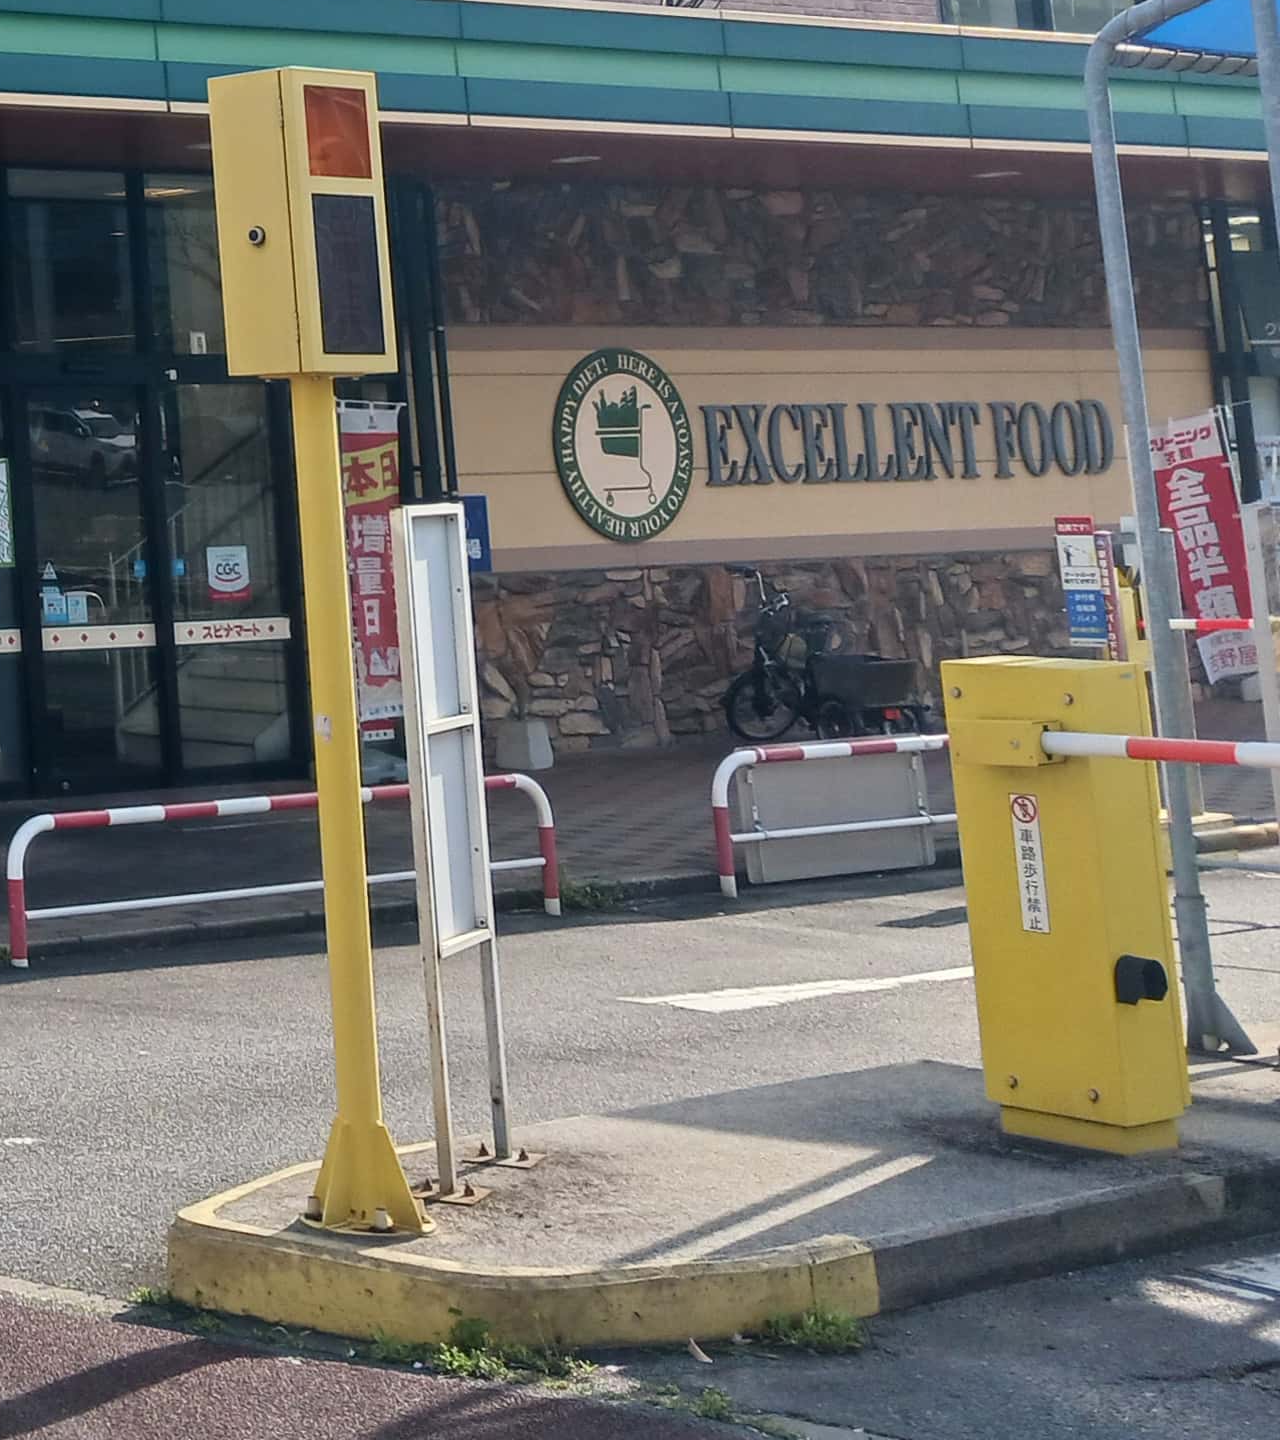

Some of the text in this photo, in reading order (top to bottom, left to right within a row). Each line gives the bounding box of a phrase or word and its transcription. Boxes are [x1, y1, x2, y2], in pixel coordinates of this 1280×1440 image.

[560, 354, 690, 537] HERE IS A TOAST TO YOUR HEALTHY HAPPY DIET!
[700, 399, 1115, 486] EXCELLENT FOOD
[216, 563, 240, 575] CGC
[351, 514, 388, 636] 増量日
[1166, 466, 1239, 620] 全品半額
[1019, 829, 1043, 931] 車路歩行禁止
